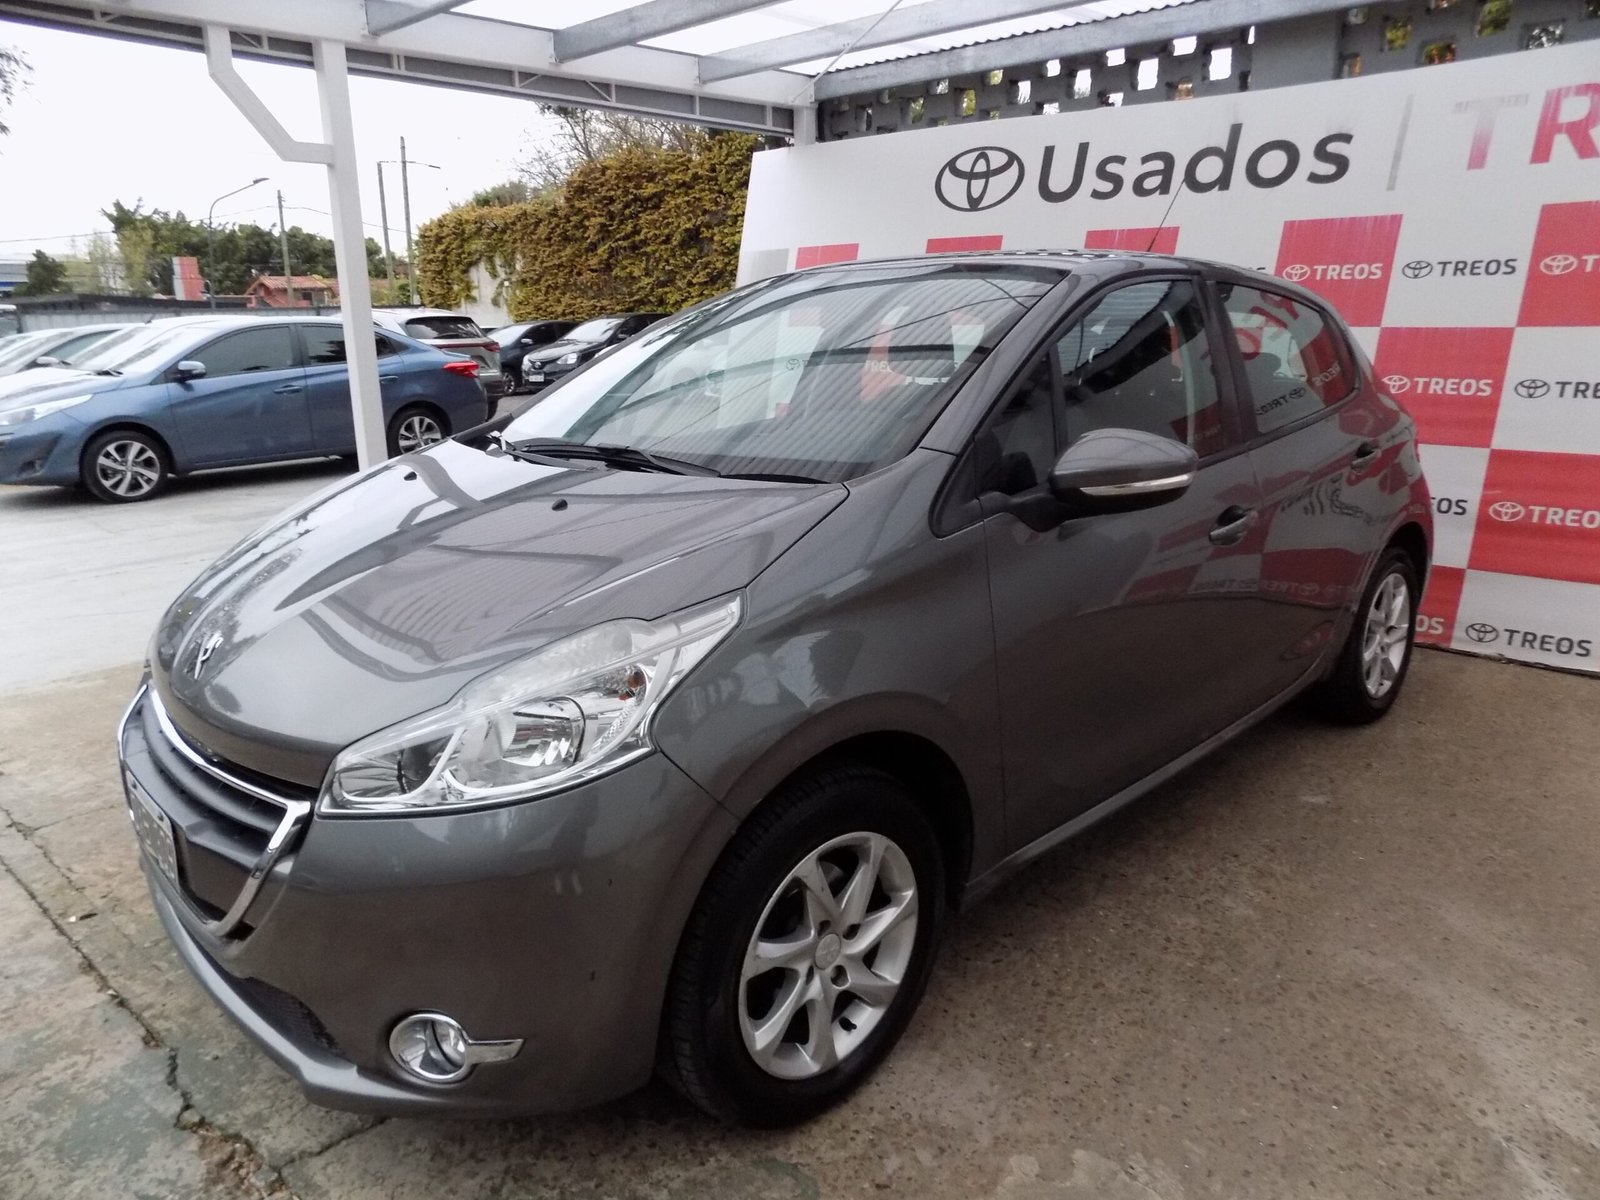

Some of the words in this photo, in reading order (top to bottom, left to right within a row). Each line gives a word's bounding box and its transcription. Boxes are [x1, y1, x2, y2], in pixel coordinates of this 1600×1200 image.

[1037, 122, 1355, 204] Usados
[1313, 263, 1384, 280] TREOS
[1437, 258, 1518, 277] TREOS
[1413, 377, 1493, 397] TREOS
[1528, 505, 1600, 529] TREO
[1503, 628, 1592, 658] TREOS
